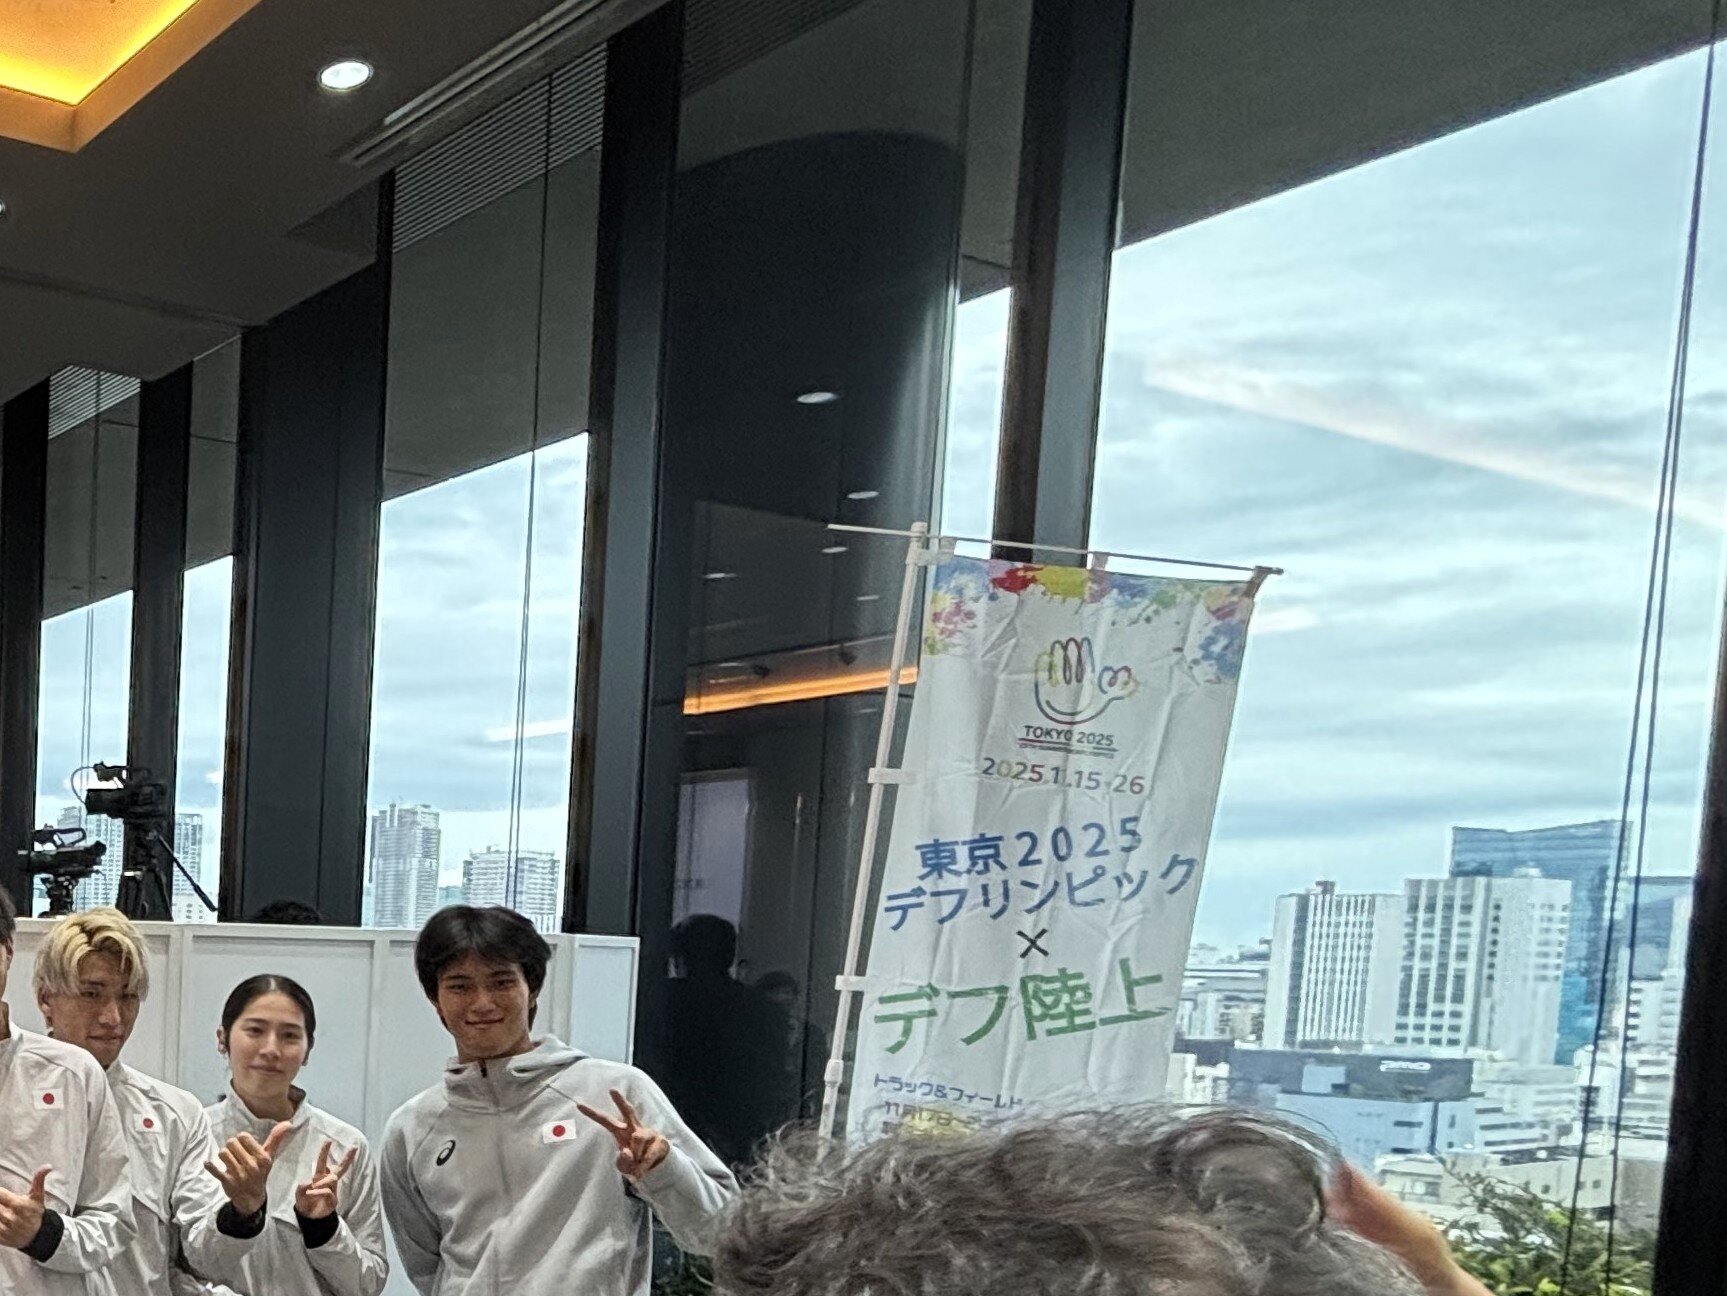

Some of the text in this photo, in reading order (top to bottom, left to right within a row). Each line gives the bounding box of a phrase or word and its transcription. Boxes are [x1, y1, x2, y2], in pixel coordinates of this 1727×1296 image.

[1024, 724, 1114, 747] TOKYO 2025
[915, 816, 1142, 881] 東京2025
[884, 853, 1198, 931] デフリンピック
[873, 957, 1173, 1055] デフ陸上
